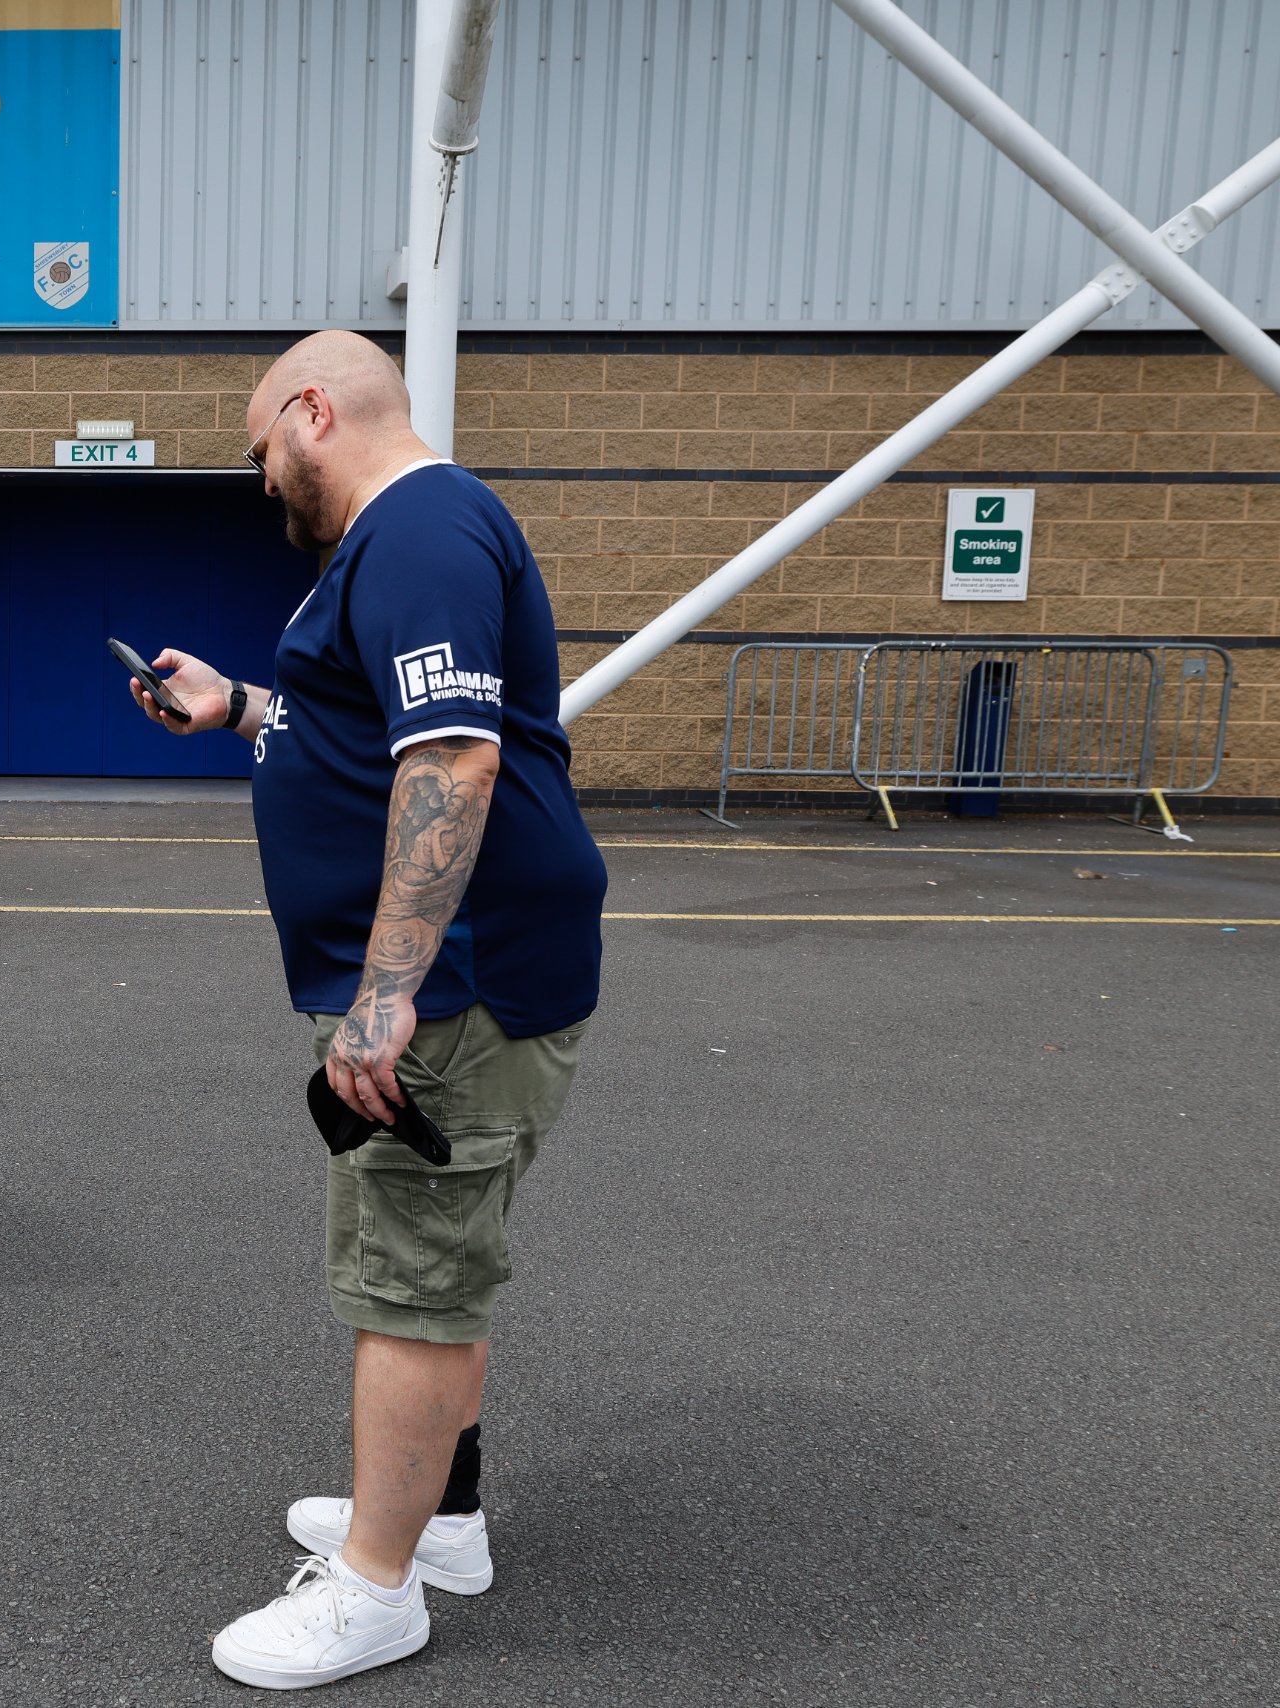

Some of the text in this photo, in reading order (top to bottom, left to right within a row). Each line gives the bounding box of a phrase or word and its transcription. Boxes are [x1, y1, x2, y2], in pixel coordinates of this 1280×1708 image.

[35, 243, 69, 269] SHREWSBURY
[59, 283, 77, 298] TOWN
[71, 445, 138, 462] EXIT 4
[959, 538, 1017, 553] Smoking
[972, 556, 1001, 565] area
[430, 687, 502, 707] WINDOWS & DOS
